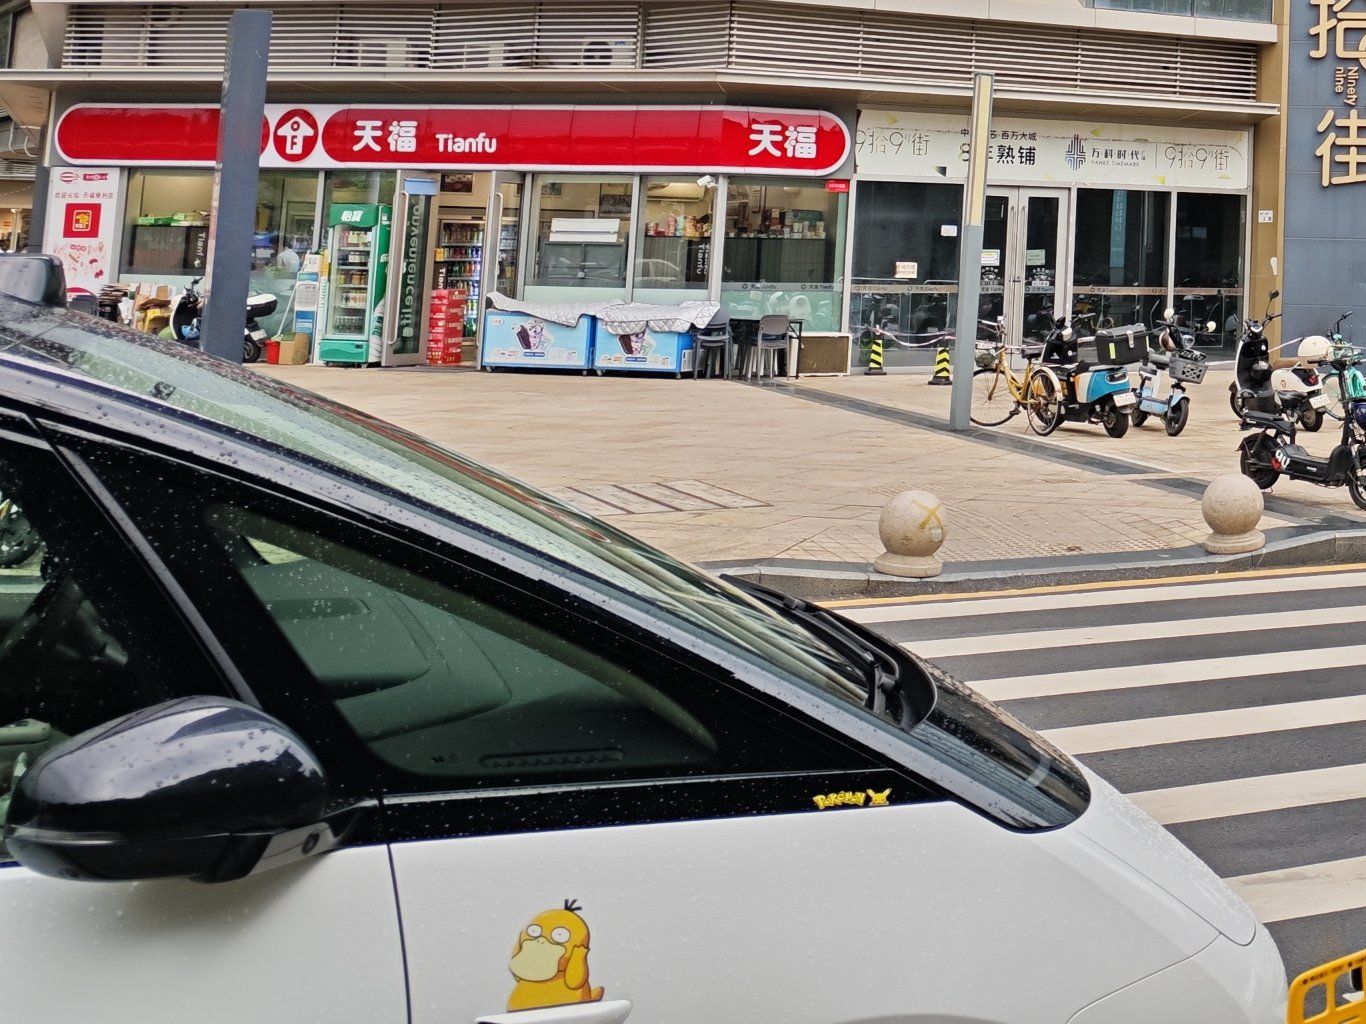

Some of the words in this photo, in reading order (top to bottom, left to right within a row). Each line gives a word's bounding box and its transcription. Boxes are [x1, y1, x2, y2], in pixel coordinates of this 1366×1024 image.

[1334, 66, 1345, 94] nine
[1344, 65, 1360, 107] Ninety
[351, 119, 419, 153] 天福
[434, 131, 498, 154] Tianfu
[748, 123, 818, 160] 天福
